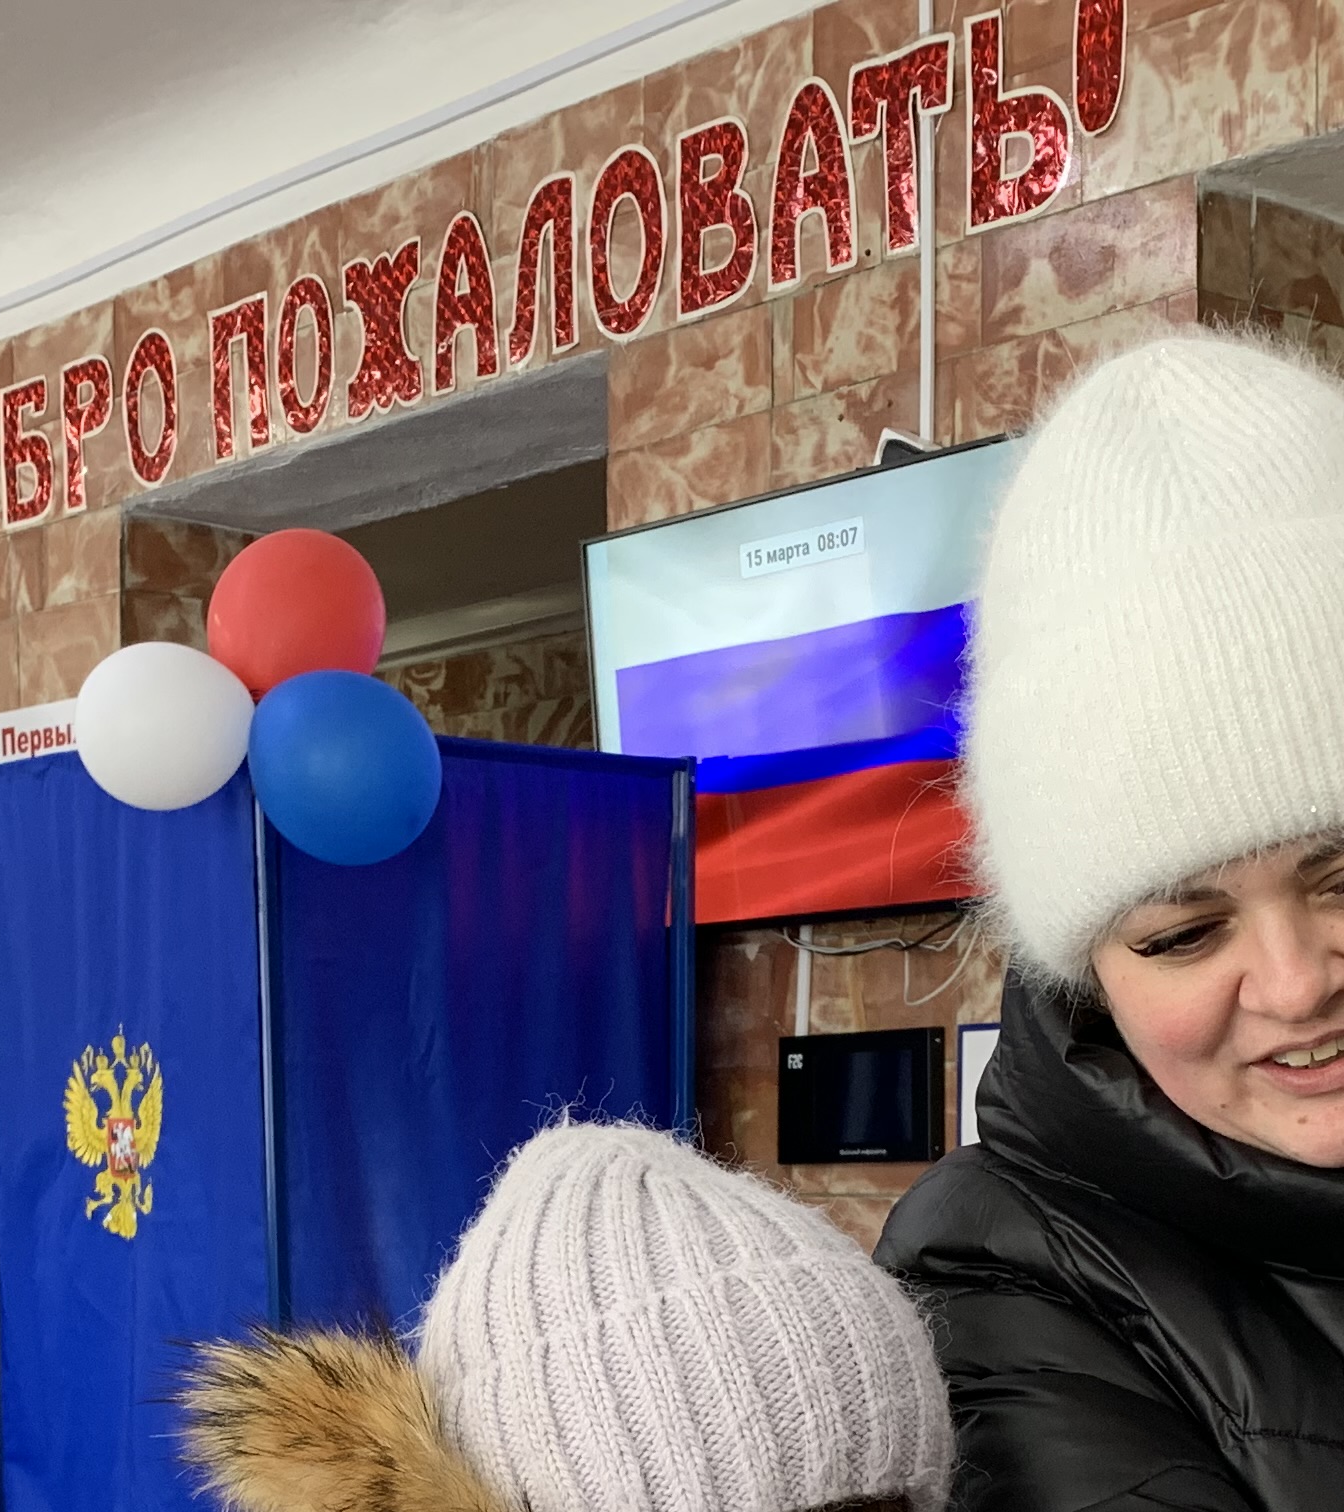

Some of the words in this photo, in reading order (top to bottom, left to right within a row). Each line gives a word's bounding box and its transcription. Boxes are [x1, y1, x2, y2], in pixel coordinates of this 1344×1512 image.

[746, 549, 763, 568] 15
[766, 542, 810, 565] марта
[817, 526, 858, 552] 08:07
[1, 723, 77, 760] Первы
